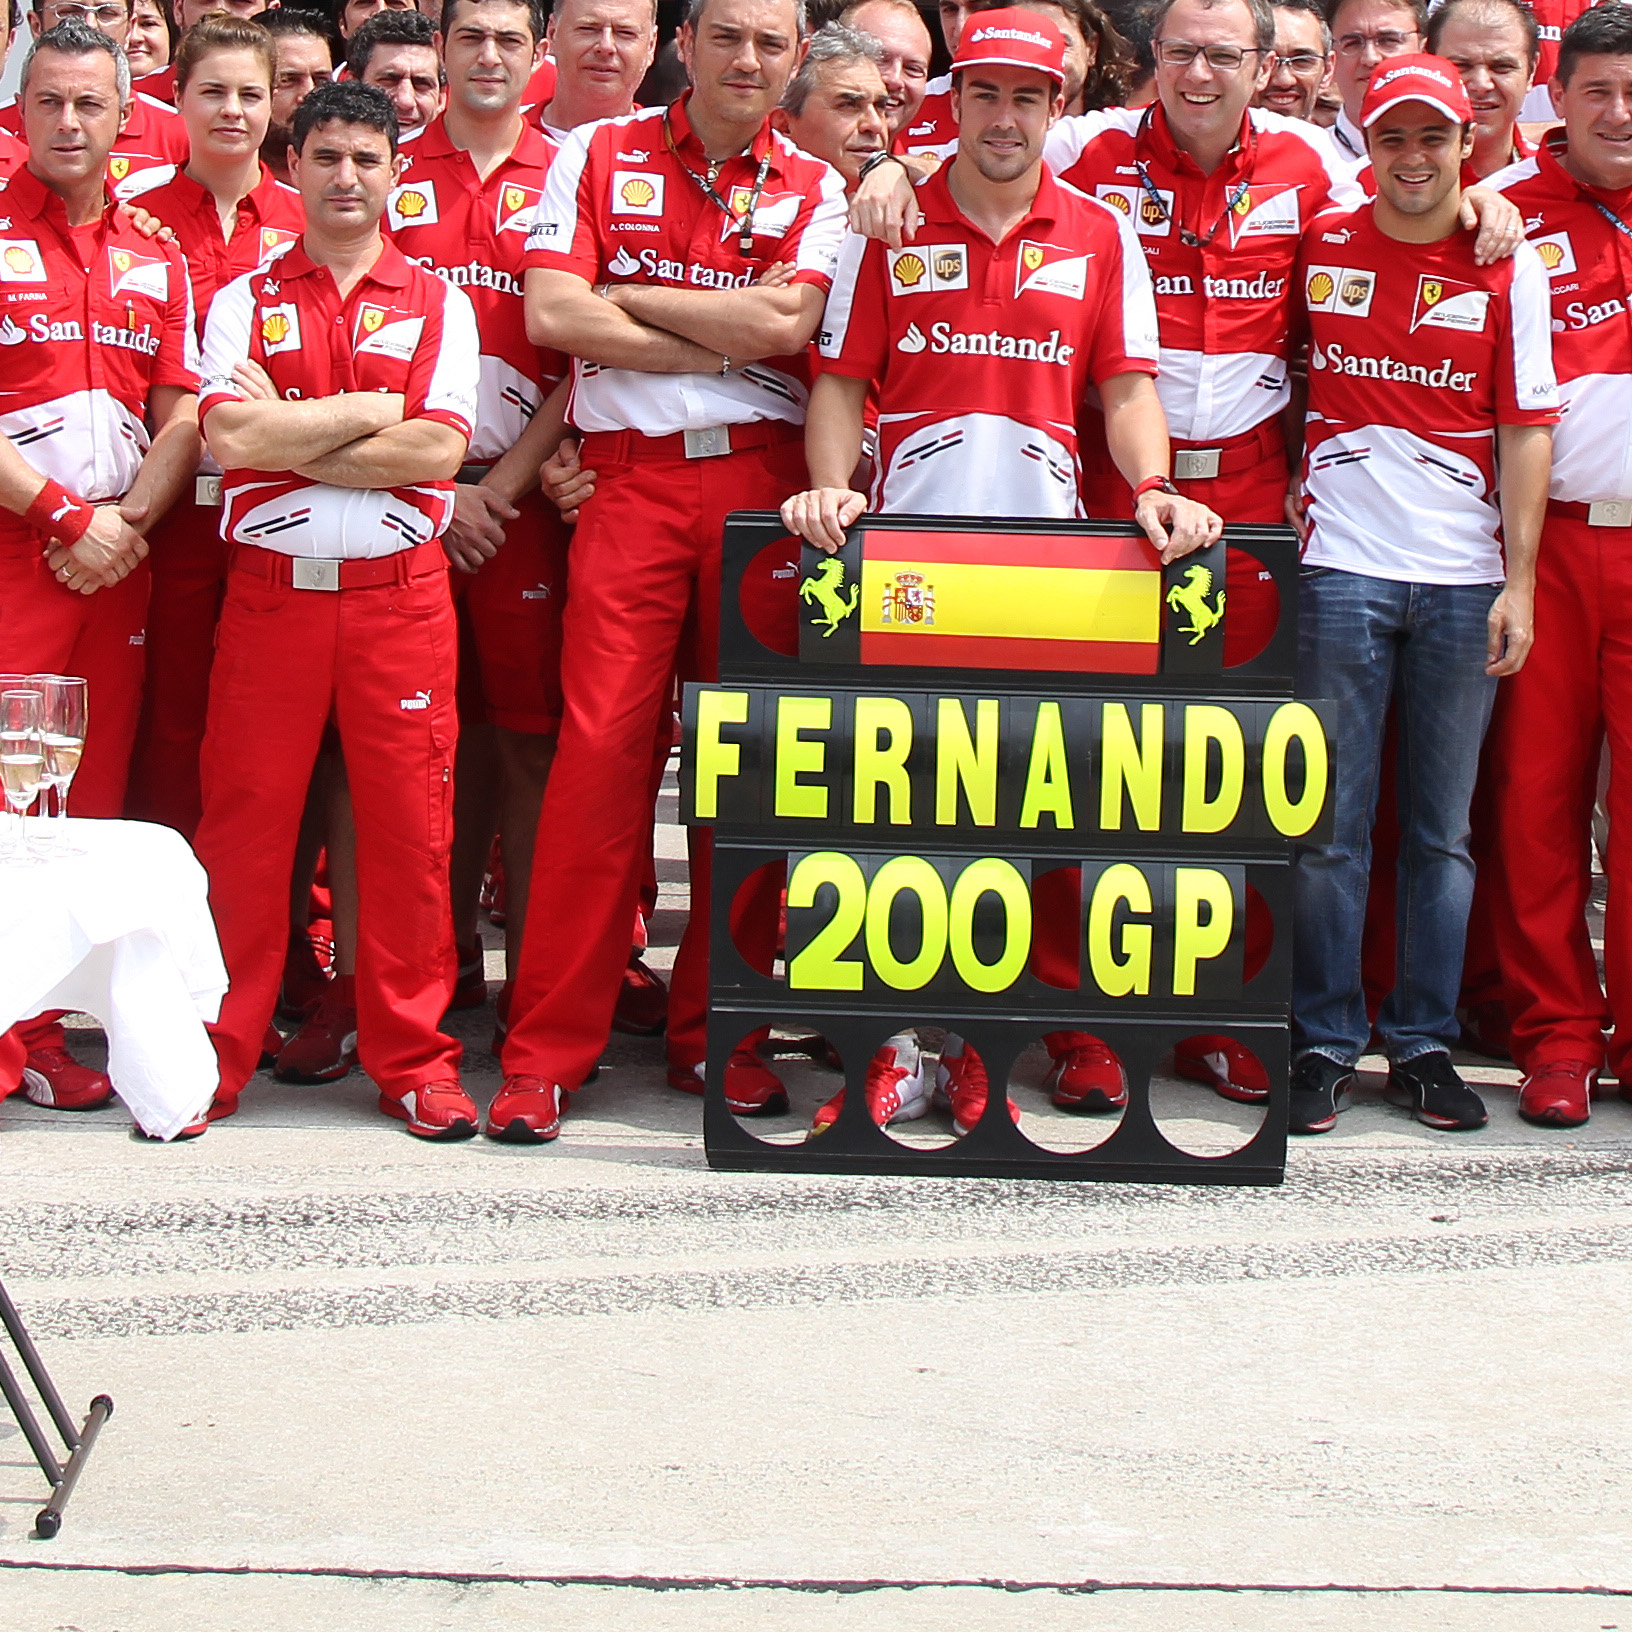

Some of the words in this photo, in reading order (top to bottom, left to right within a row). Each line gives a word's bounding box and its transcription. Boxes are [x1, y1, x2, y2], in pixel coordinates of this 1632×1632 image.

[982, 26, 1053, 49] Santander
[1386, 64, 1453, 88] Santander
[417, 257, 525, 296] Santan
[935, 257, 961, 277] ups
[17, 292, 48, 302] FARINA
[1150, 270, 1285, 299] antander
[1341, 282, 1368, 300] ups
[1326, 343, 1478, 392] Santander
[694, 689, 1329, 838] FERNANDO
[786, 851, 1033, 994] 200
[1087, 862, 1236, 997] GP
